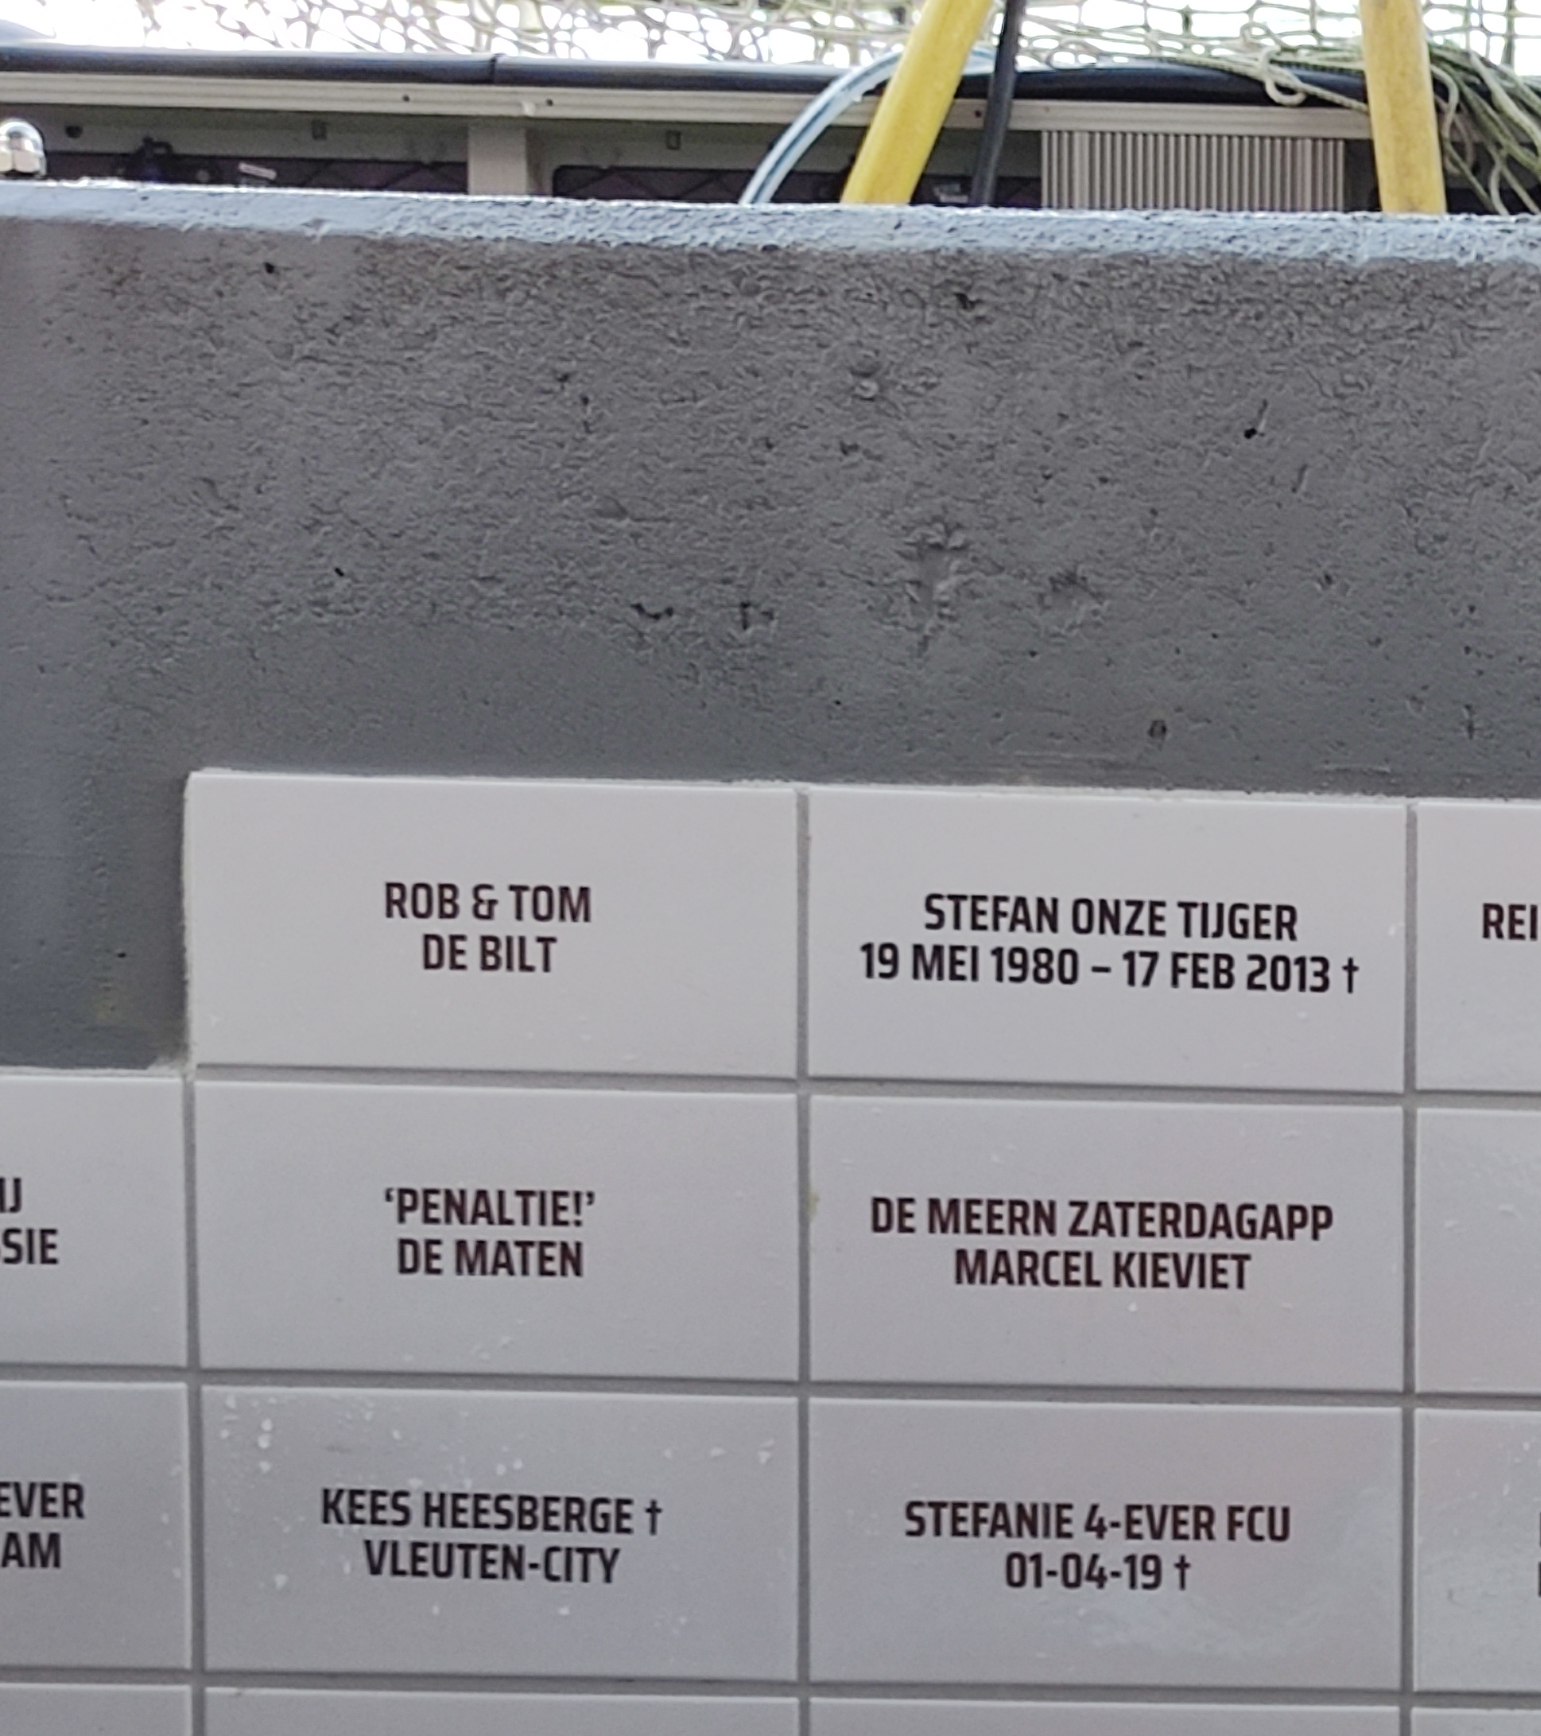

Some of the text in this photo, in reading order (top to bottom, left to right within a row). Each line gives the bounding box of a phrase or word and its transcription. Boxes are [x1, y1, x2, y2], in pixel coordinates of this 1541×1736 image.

[385, 882, 590, 922] ROB & TOM
[925, 893, 1297, 941] STEFAN ONZE TIJGER
[423, 934, 557, 973] DE BILT
[871, 1197, 1333, 1241] DE MEERN ZATERDAGAPP
[398, 1238, 583, 1277] DE MATEN
[955, 1248, 1251, 1290] MARCEL KIEVIET
[322, 1488, 634, 1534] KEES HEESBERGE
[905, 1501, 1290, 1542] STEFANIE 4-EVER FCU
[363, 1539, 620, 1583] VLEUTEN-CITY
[1006, 1552, 1162, 1590] 01-04-19
